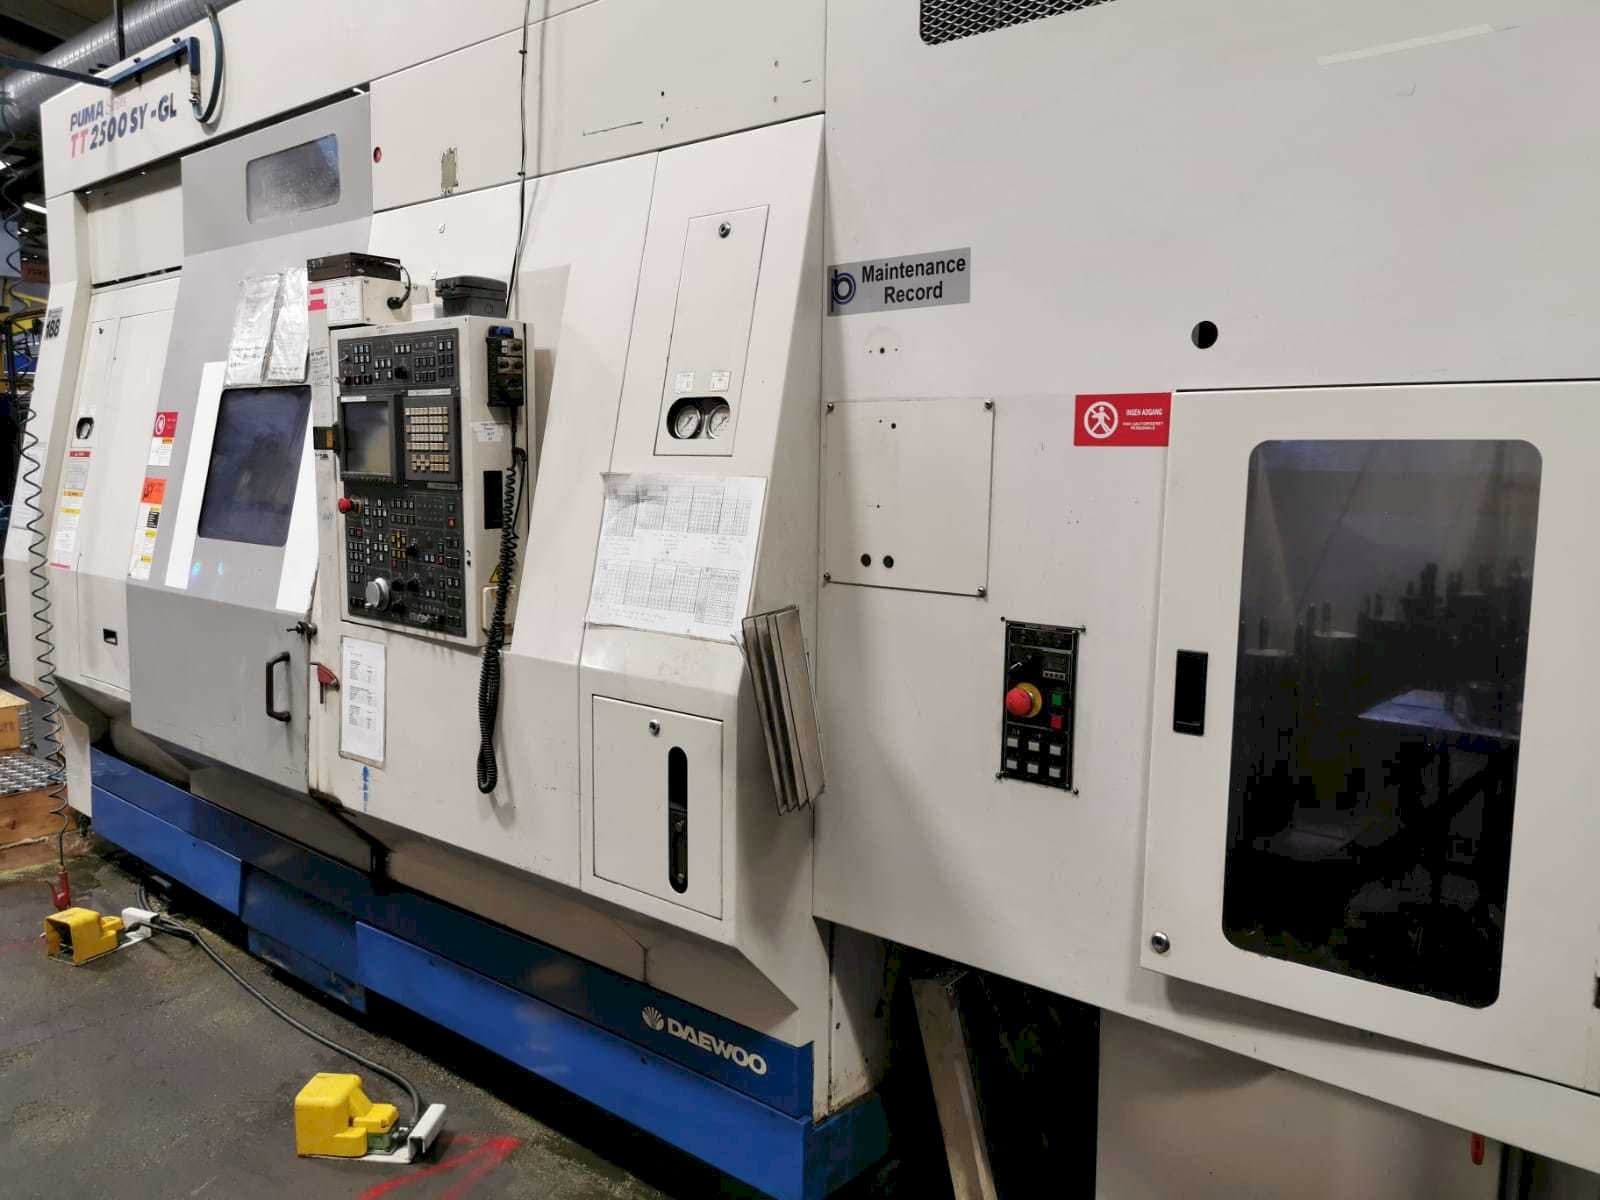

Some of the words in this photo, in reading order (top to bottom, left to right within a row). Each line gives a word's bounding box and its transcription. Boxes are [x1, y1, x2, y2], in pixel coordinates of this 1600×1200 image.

[70, 100, 104, 131] PUMA
[861, 257, 967, 284] Maintenance
[884, 280, 944, 304] Record
[667, 1017, 768, 1075] DAEWOO
